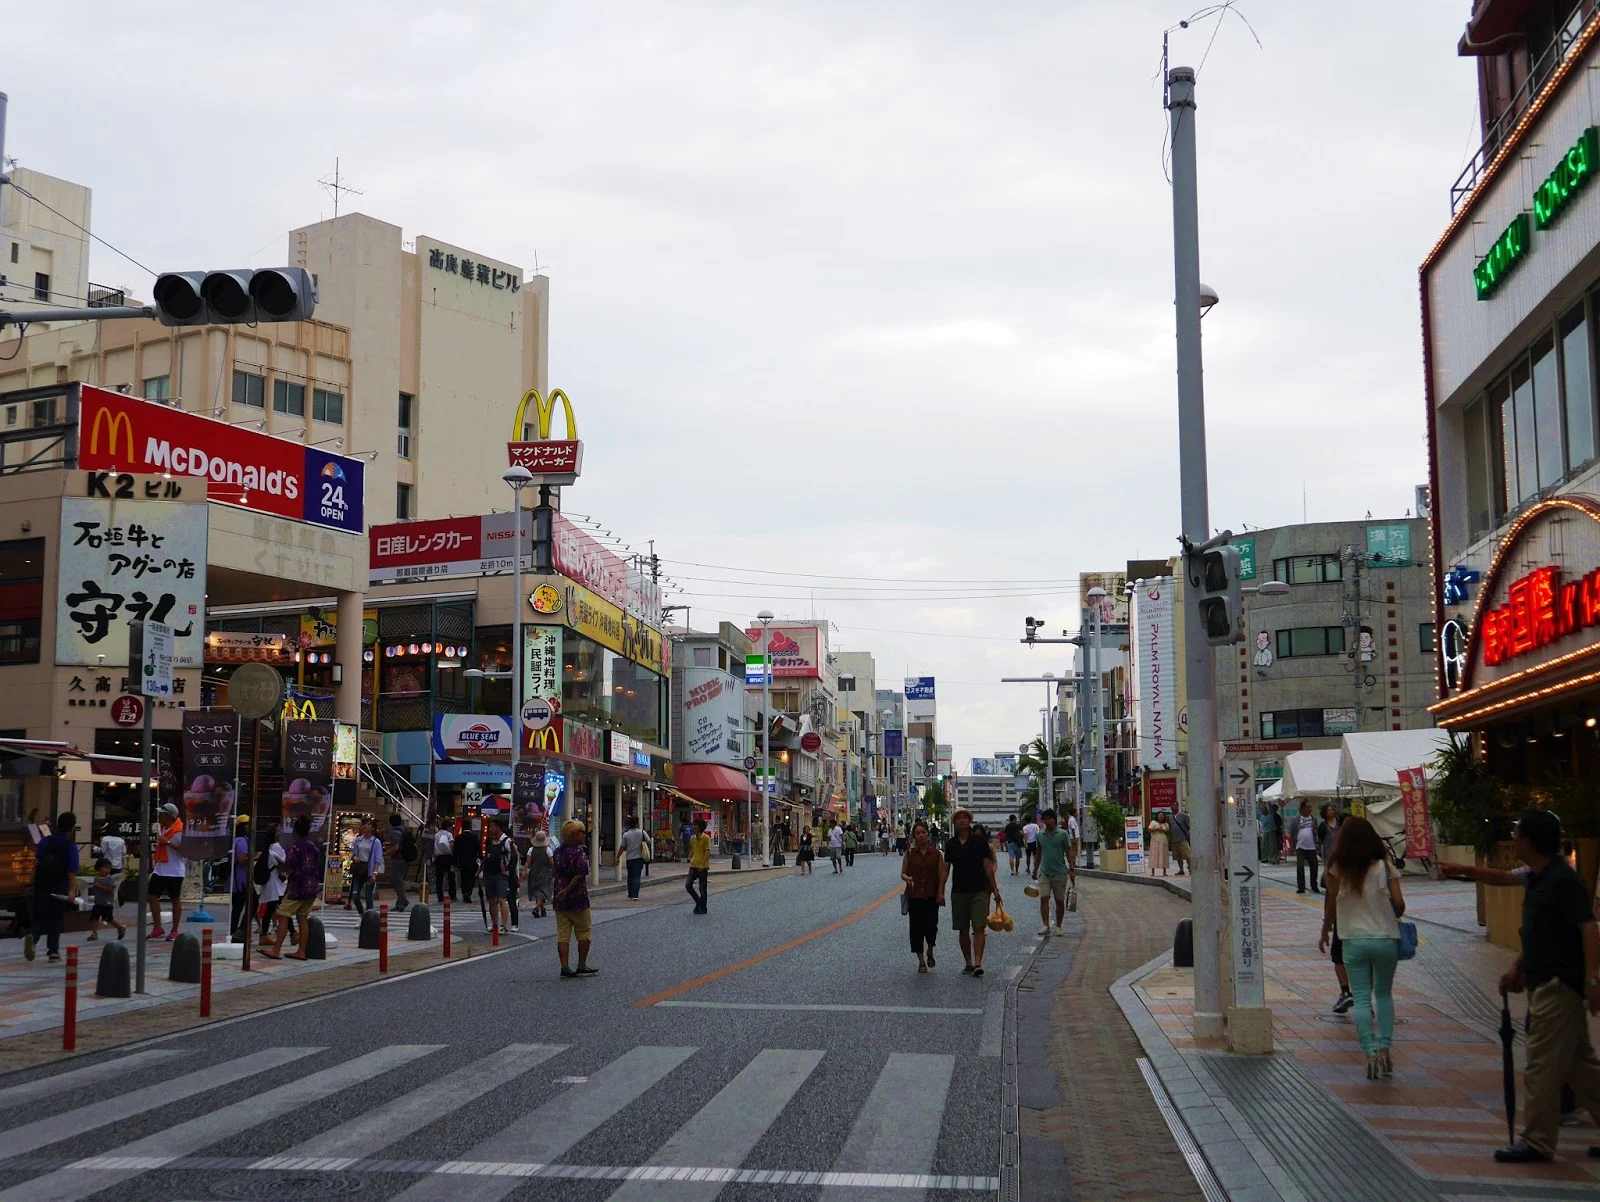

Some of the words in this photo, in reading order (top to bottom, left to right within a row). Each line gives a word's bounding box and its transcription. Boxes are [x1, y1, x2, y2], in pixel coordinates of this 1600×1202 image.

[429, 248, 520, 293] 高良産業ビル
[511, 445, 574, 457] マクドナルド
[144, 437, 299, 499] McDonald's
[512, 457, 574, 468] ハンバーガー
[87, 471, 134, 499] K2
[145, 480, 182, 498] ビル
[320, 506, 344, 522] OPEN
[73, 521, 165, 548] 石垣牛と
[376, 531, 473, 556] 日産レンタカー
[486, 529, 526, 540] NISSAN
[1369, 529, 1404, 542] 漢方
[480, 559, 513, 570] 左折10m
[1390, 545, 1407, 563] 薬
[108, 553, 195, 579] アグーの店
[396, 565, 448, 577] 那覇国際通り店
[66, 580, 194, 644] 守礼
[1150, 623, 1160, 661] PALM
[544, 634, 556, 690] 沖縄地料理
[530, 648, 542, 699] 民謡ライ
[1151, 663, 1161, 709] ROYAL
[698, 716, 708, 726] CD
[461, 732, 479, 740] BLUE
[480, 732, 498, 741] SEAL
[1153, 711, 1163, 758] NAHA
[1225, 744, 1252, 752] Kokusai
[517, 772, 544, 780] フローズン
[466, 792, 481, 801] K2
[1235, 788, 1247, 828] 平和通り
